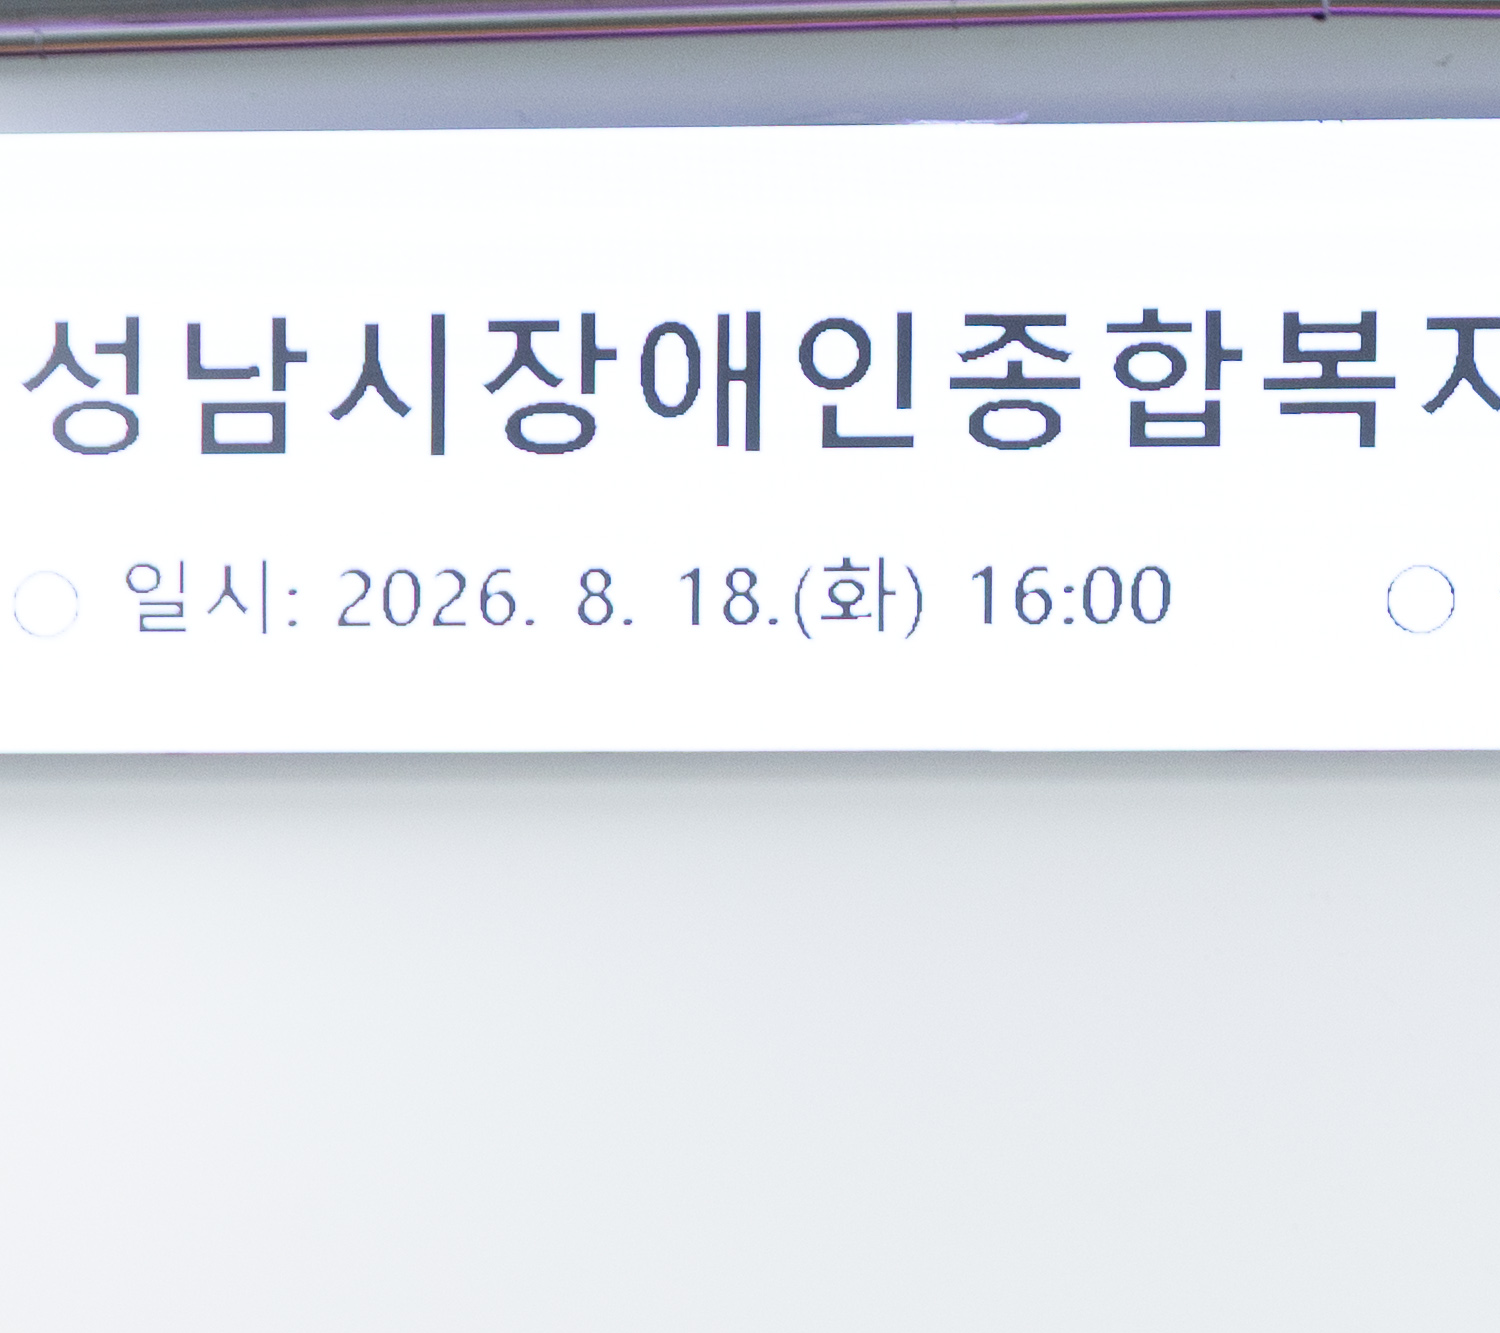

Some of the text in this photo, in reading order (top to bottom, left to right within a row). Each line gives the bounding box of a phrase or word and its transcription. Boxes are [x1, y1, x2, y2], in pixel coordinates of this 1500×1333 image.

[125, 556, 1172, 640] 일시: 2026. 8. 18.(화) 16:00
